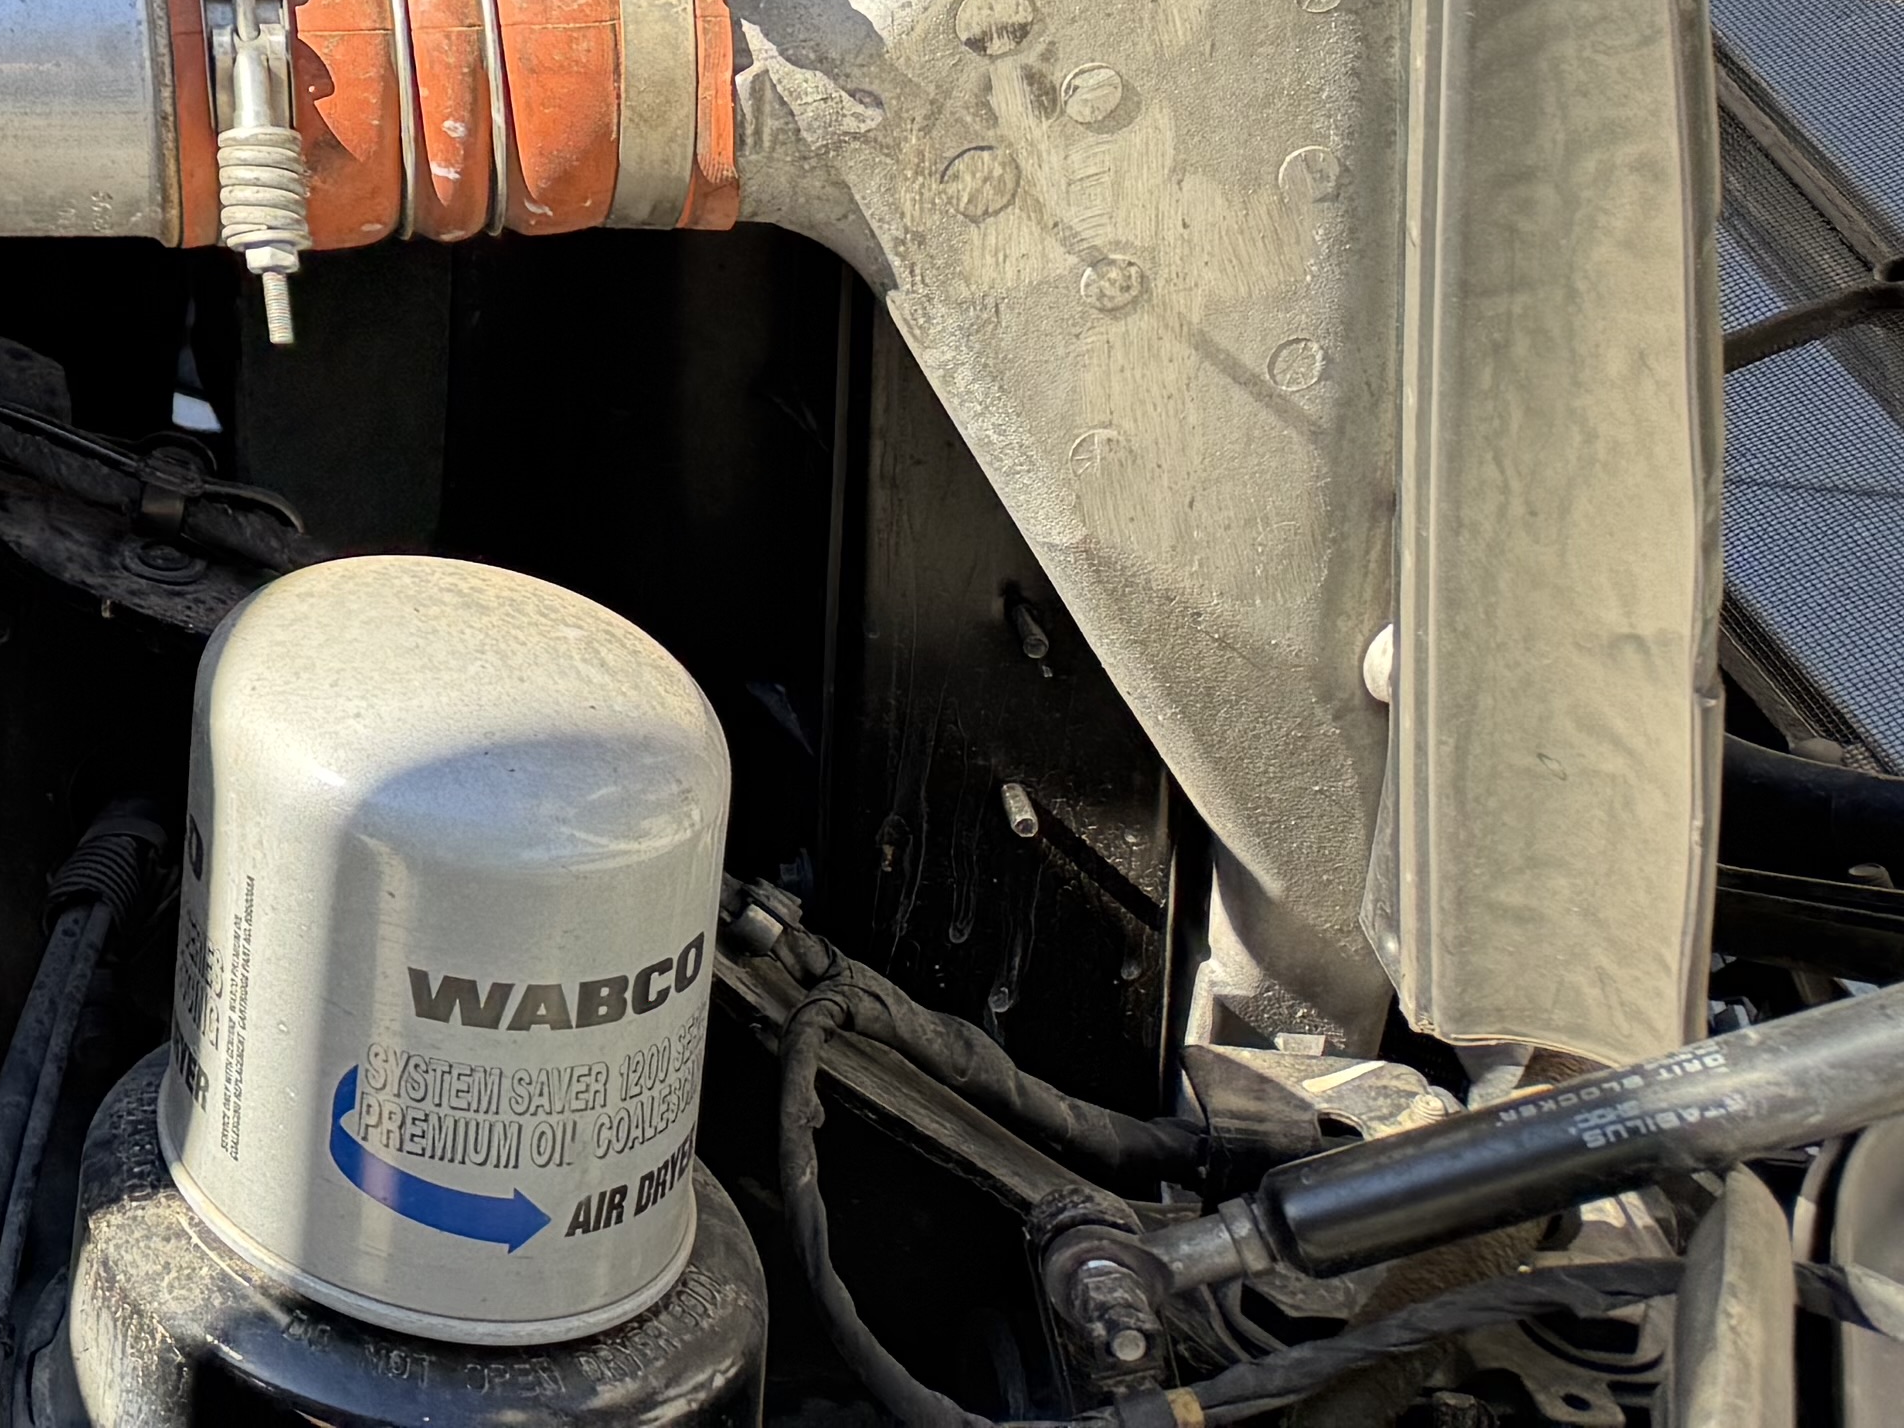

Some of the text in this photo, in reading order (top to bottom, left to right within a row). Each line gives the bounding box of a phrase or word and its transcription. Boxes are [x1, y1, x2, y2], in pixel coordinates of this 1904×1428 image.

[407, 930, 705, 1031] WABCO
[366, 1043, 502, 1115] SYSTEM
[508, 1061, 609, 1116] SAVER
[619, 1036, 671, 1101] 1200
[1499, 1074, 1645, 1123] BLOCKER
[357, 1093, 523, 1169] PREMIUM
[530, 1119, 577, 1167] OIL
[565, 1184, 628, 1238] AIR
[464, 1357, 567, 1397] OPEN
